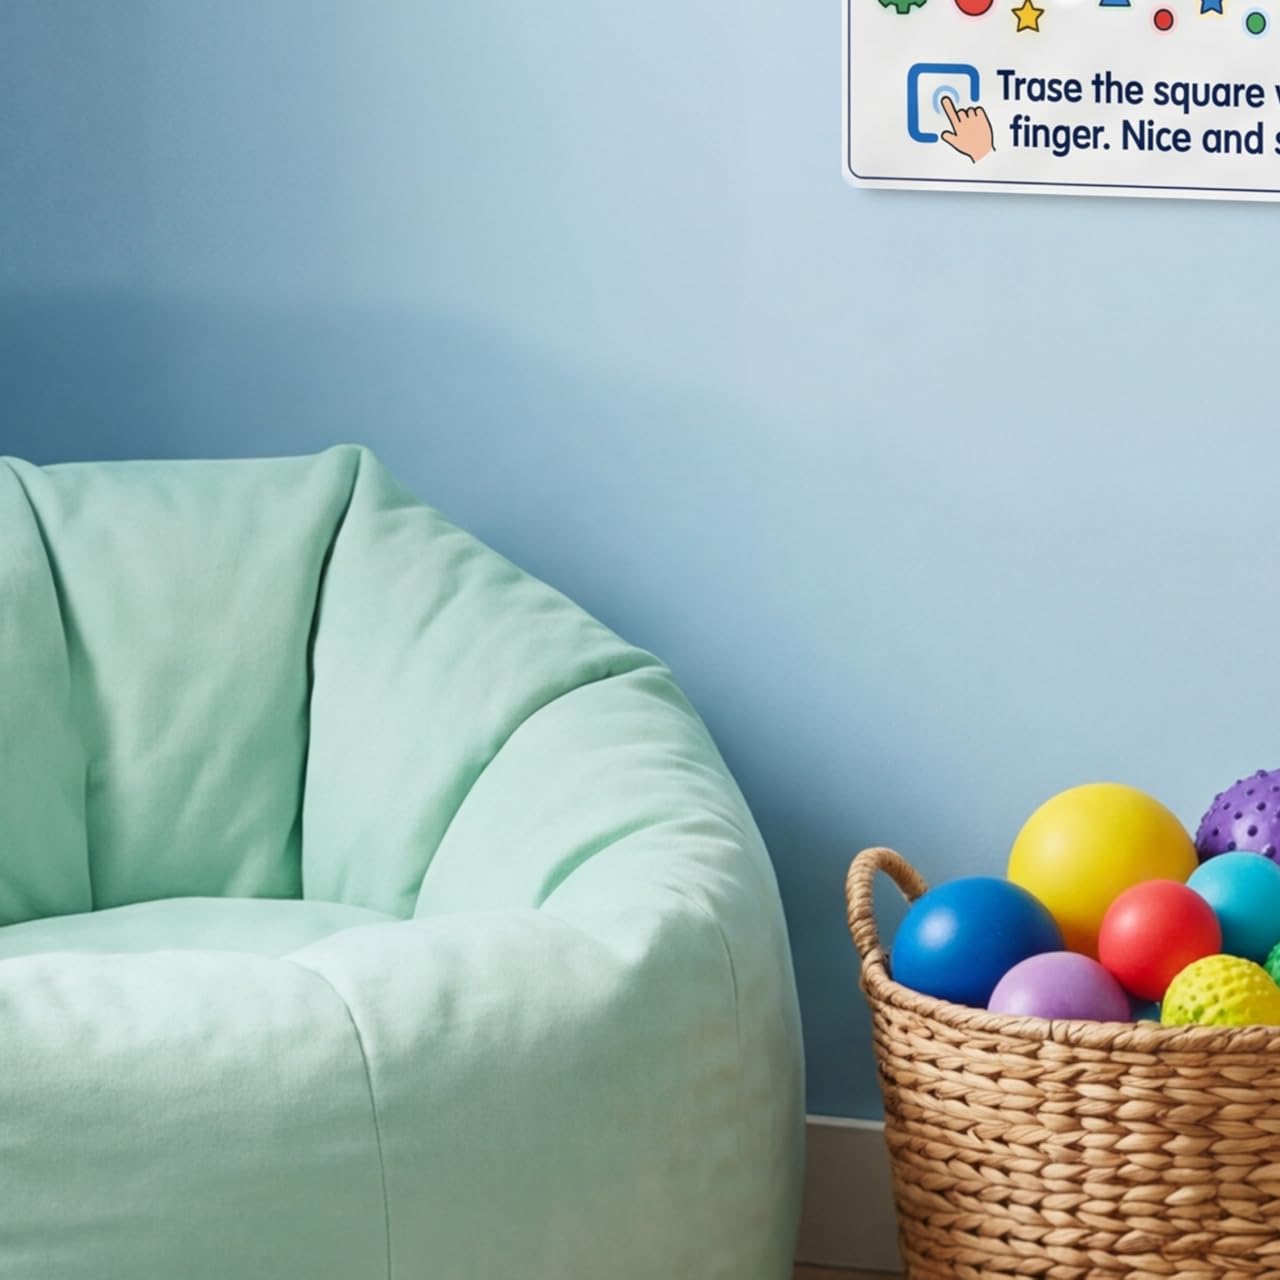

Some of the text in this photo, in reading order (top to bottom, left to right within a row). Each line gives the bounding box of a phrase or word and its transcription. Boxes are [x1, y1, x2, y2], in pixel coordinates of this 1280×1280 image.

[997, 69, 1082, 102] Trase
[1091, 71, 1144, 105] the
[1153, 80, 1265, 114] square
[1009, 115, 1111, 158] finger.
[1122, 119, 1191, 153] Nice
[1202, 122, 1264, 155] and
